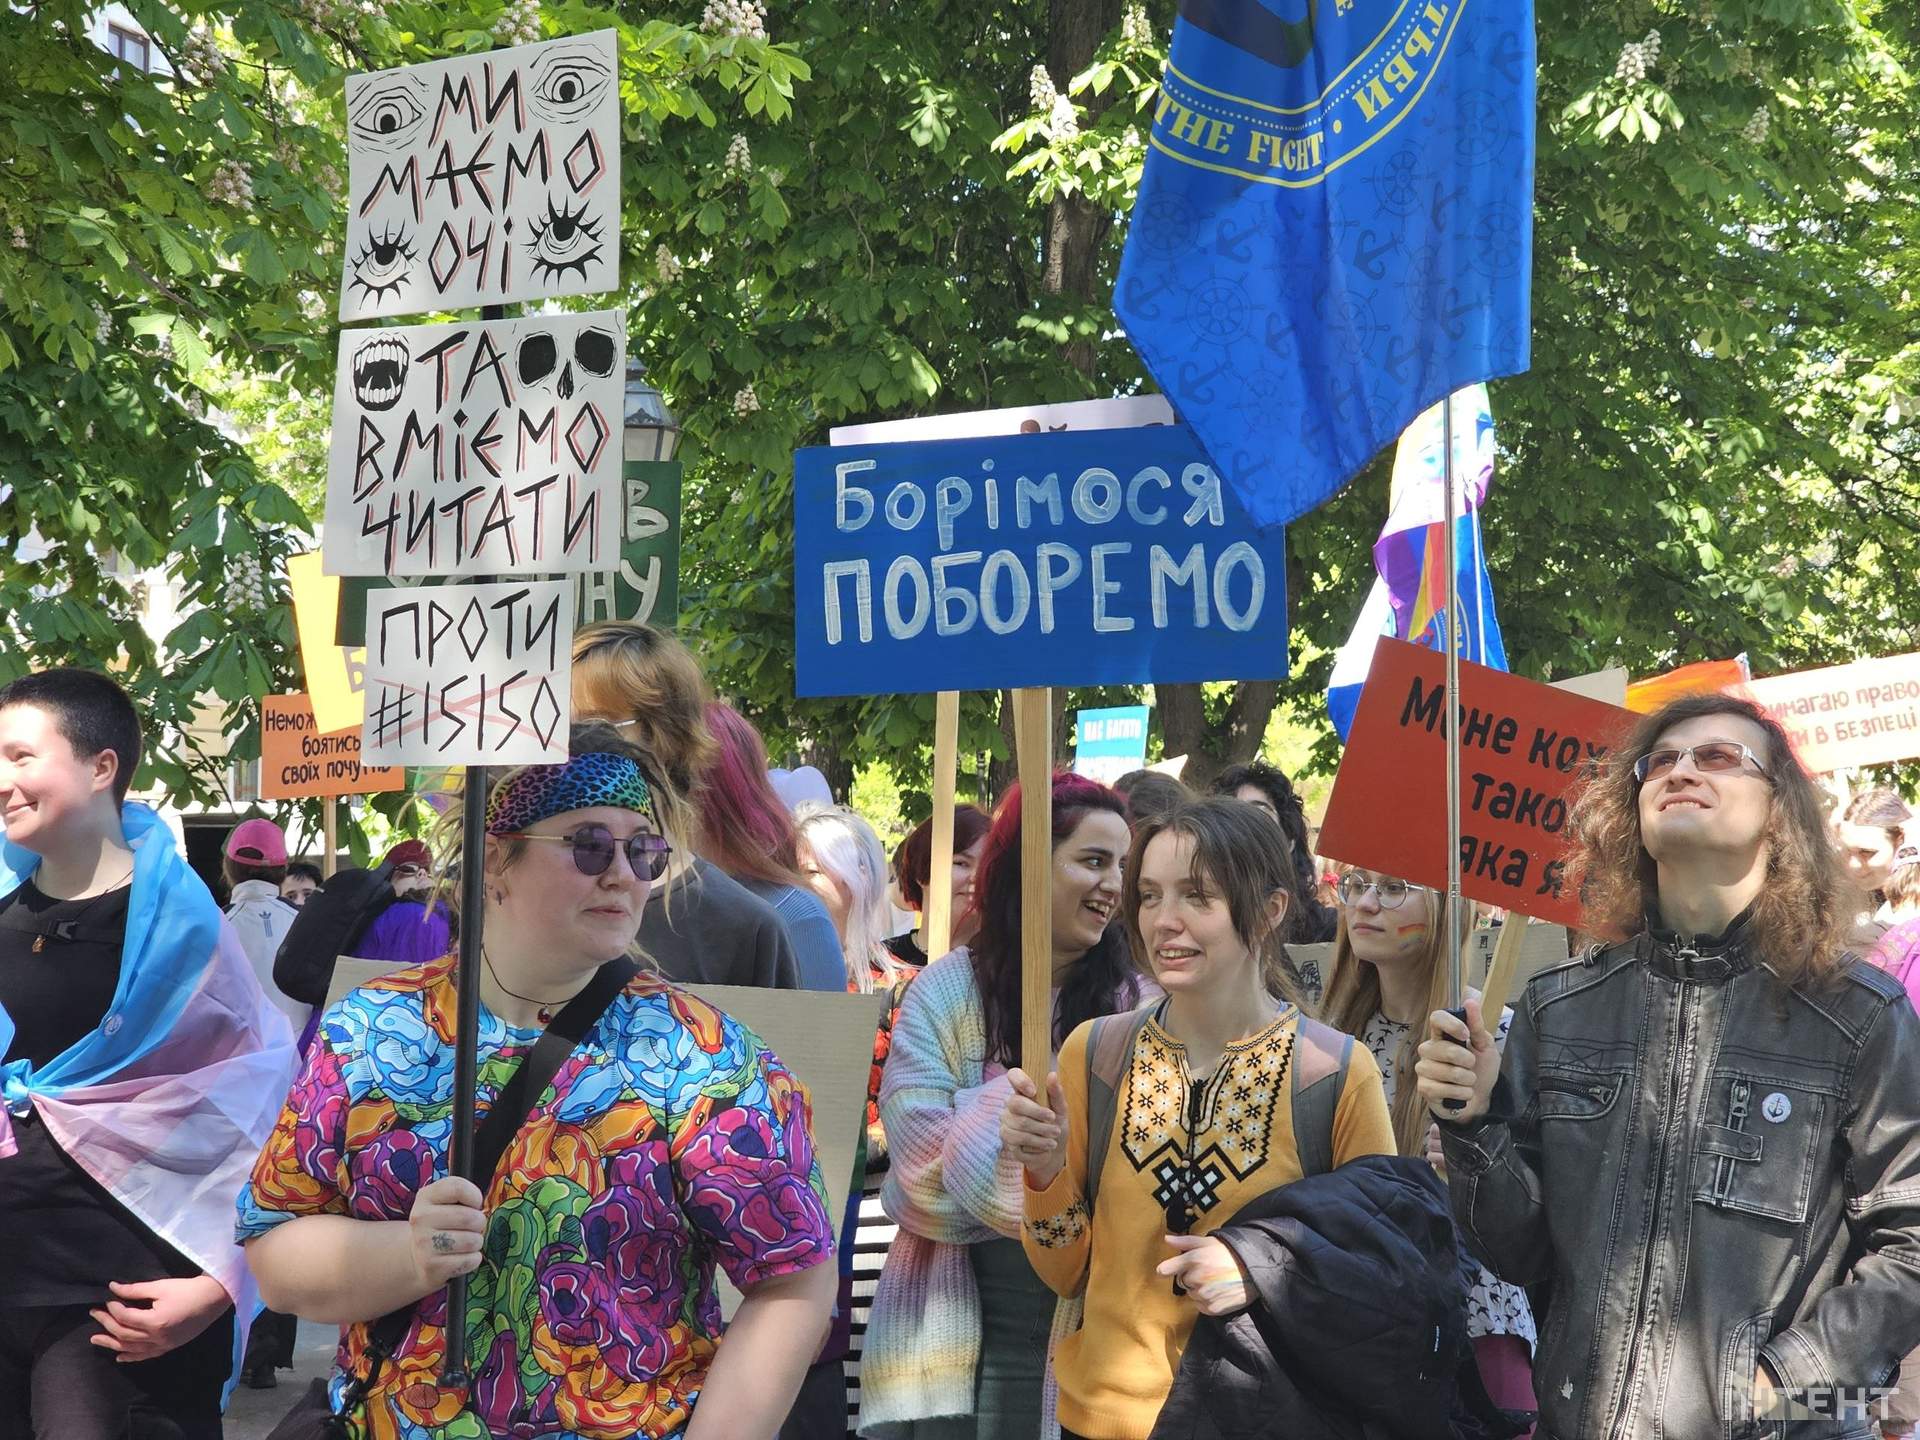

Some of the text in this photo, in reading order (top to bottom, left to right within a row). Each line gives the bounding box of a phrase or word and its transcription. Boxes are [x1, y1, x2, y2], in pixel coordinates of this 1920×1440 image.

[428, 60, 526, 149] МИ
[1154, 93, 1324, 171] THE FIGHT
[359, 127, 607, 224] МАЄМО
[415, 328, 517, 414] ТА
[362, 473, 603, 577] ЧИТАТИ
[835, 458, 1225, 551] Борімося
[380, 588, 561, 672] ПРОТИ
[823, 540, 1267, 645] ПОБОРЕМО
[265, 709, 318, 732] Немож
[1768, 680, 1920, 719] имагаю право
[281, 759, 391, 785] своїх почу
[302, 735, 361, 758] боятись
[1472, 772, 1568, 834] тако
